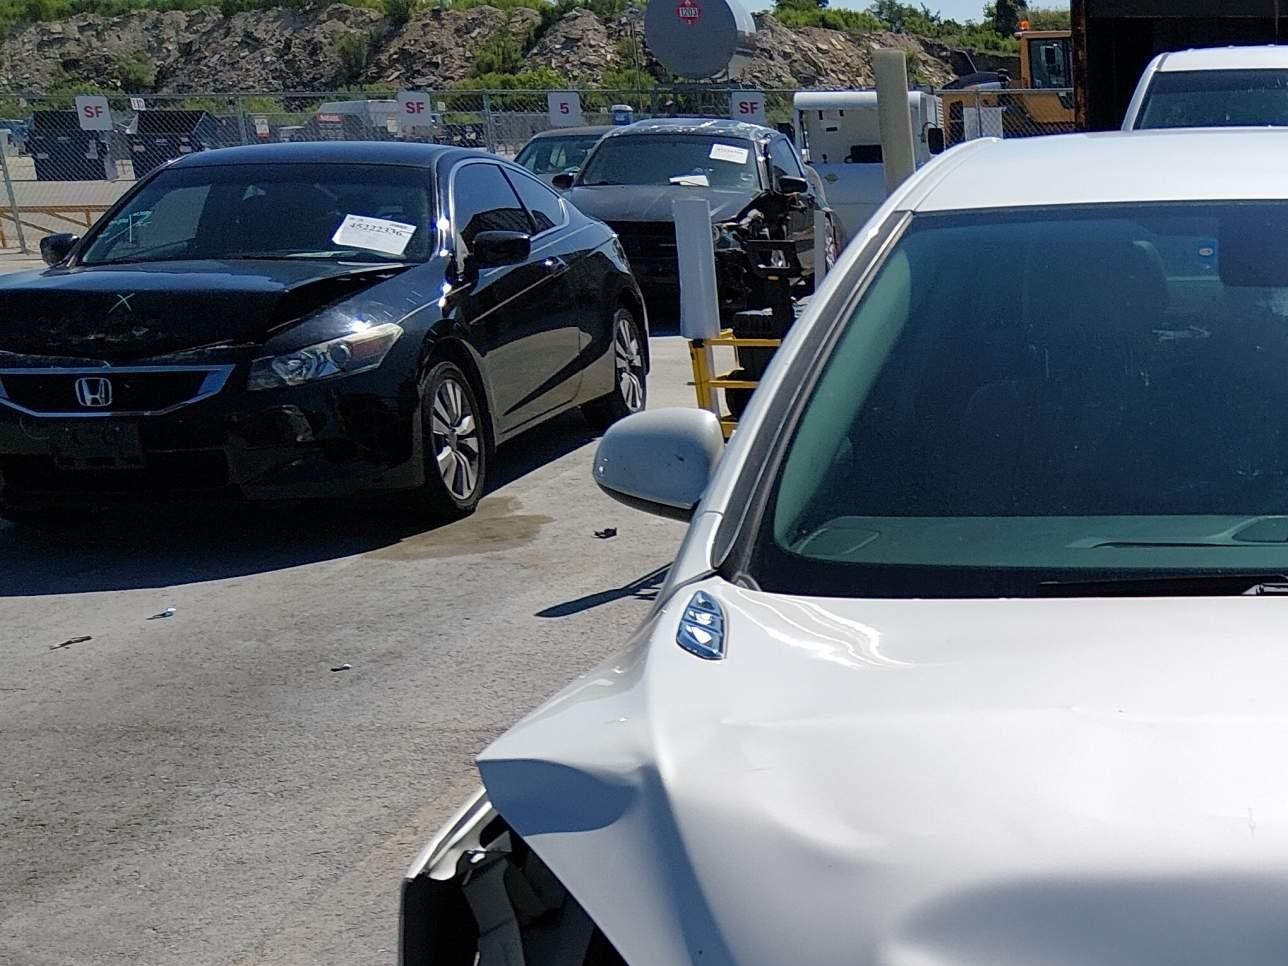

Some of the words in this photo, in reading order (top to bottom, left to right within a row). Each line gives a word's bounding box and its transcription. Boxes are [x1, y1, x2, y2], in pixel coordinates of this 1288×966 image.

[83, 105, 104, 118] SF
[405, 101, 425, 114] SF
[559, 102, 570, 114] 5
[739, 102, 759, 114] SF
